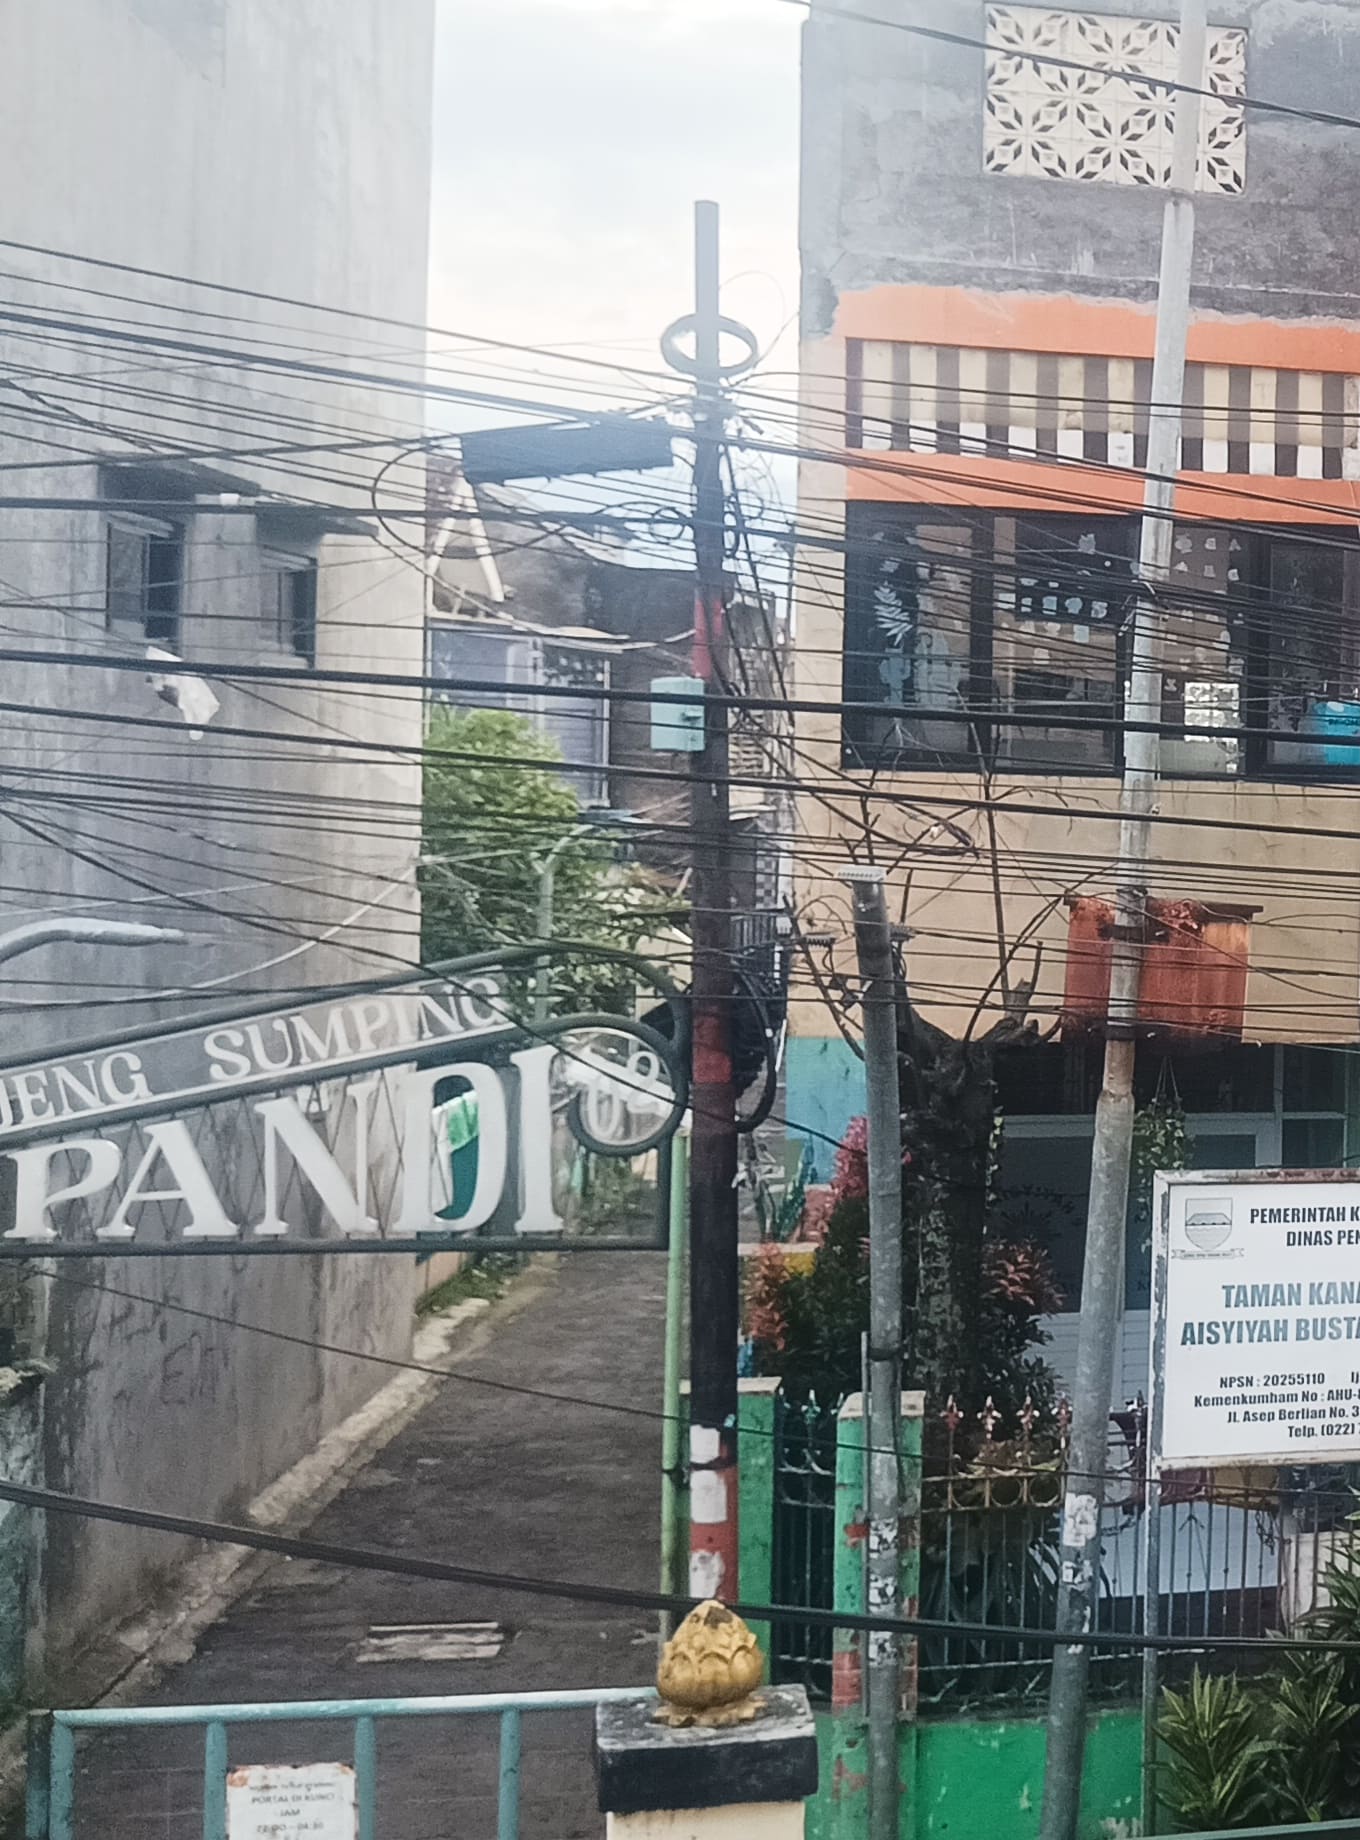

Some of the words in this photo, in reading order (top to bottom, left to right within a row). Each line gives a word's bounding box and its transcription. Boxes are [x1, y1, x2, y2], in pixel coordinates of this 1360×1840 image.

[204, 978, 508, 1081] SUMPING
[3, 1045, 564, 1239] PANDI
[1250, 1206, 1346, 1224] PEMERINTAH
[1286, 1230, 1333, 1246] DINAS
[1222, 1283, 1301, 1308] TAMAN
[1180, 1319, 1288, 1346] AISYIYAH
[1219, 1375, 1253, 1388] NPSN
[1263, 1373, 1325, 1386] 20255110
[1194, 1392, 1298, 1407] Kemenkumham
[1301, 1390, 1318, 1402] No
[1242, 1410, 1275, 1422] Asep
[1278, 1407, 1326, 1420] Berlian
[1329, 1406, 1348, 1418] No.
[1288, 1425, 1317, 1438] Telp.
[1321, 1422, 1355, 1436] (022)
